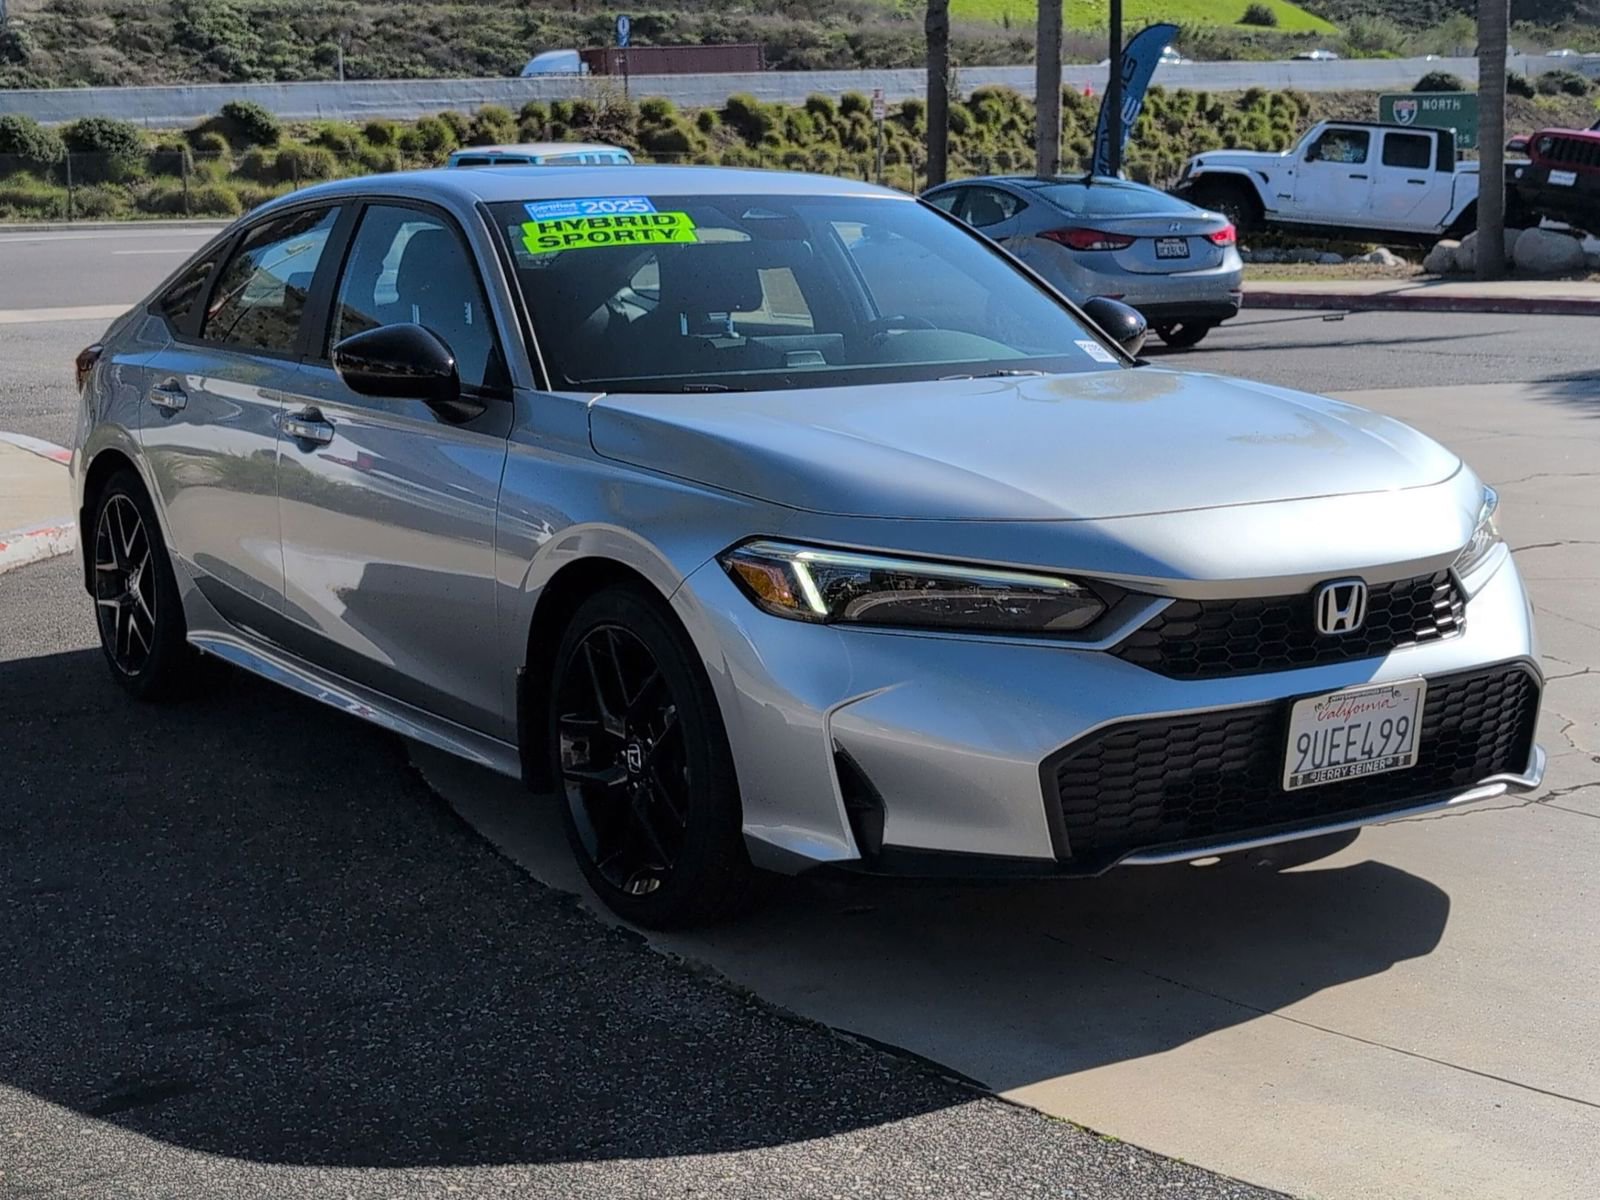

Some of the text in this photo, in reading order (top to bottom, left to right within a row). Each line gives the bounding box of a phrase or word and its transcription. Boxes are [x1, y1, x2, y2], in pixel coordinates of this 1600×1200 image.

[1422, 98, 1461, 110] NORTH
[1400, 109, 1409, 122] 5
[582, 199, 649, 214] 2025
[539, 214, 677, 234] HYBRID
[537, 228, 675, 248] SPORTY
[1317, 697, 1397, 723] California
[1294, 715, 1410, 774] 9UEE499
[1314, 759, 1386, 782] JERRY SEINER
